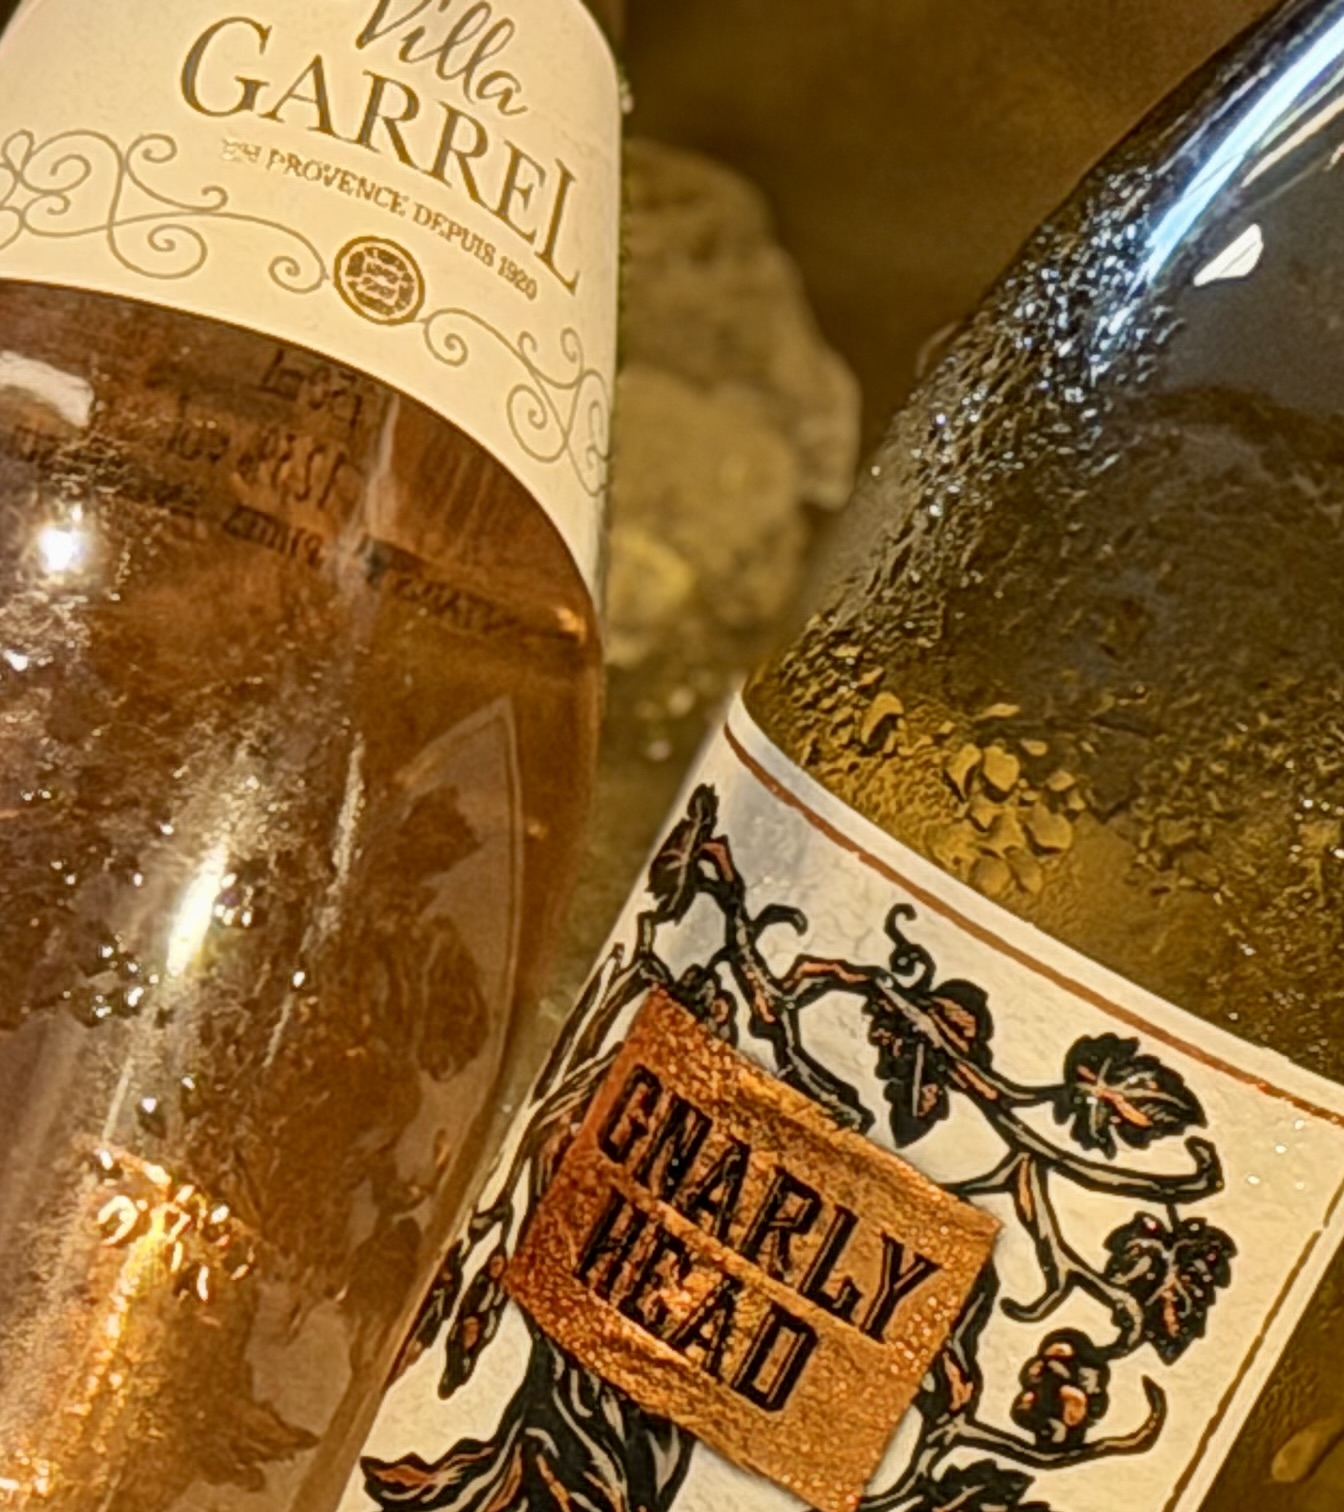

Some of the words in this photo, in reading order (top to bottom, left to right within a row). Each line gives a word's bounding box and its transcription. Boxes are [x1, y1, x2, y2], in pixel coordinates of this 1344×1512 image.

[180, 17, 581, 295] GARREL
[355, 0, 529, 116] Villa
[265, 148, 409, 217] PROVENCE
[412, 202, 497, 267] DEPUIS
[574, 1185, 820, 1414] HEAD
[596, 1062, 944, 1346] GNARLY
